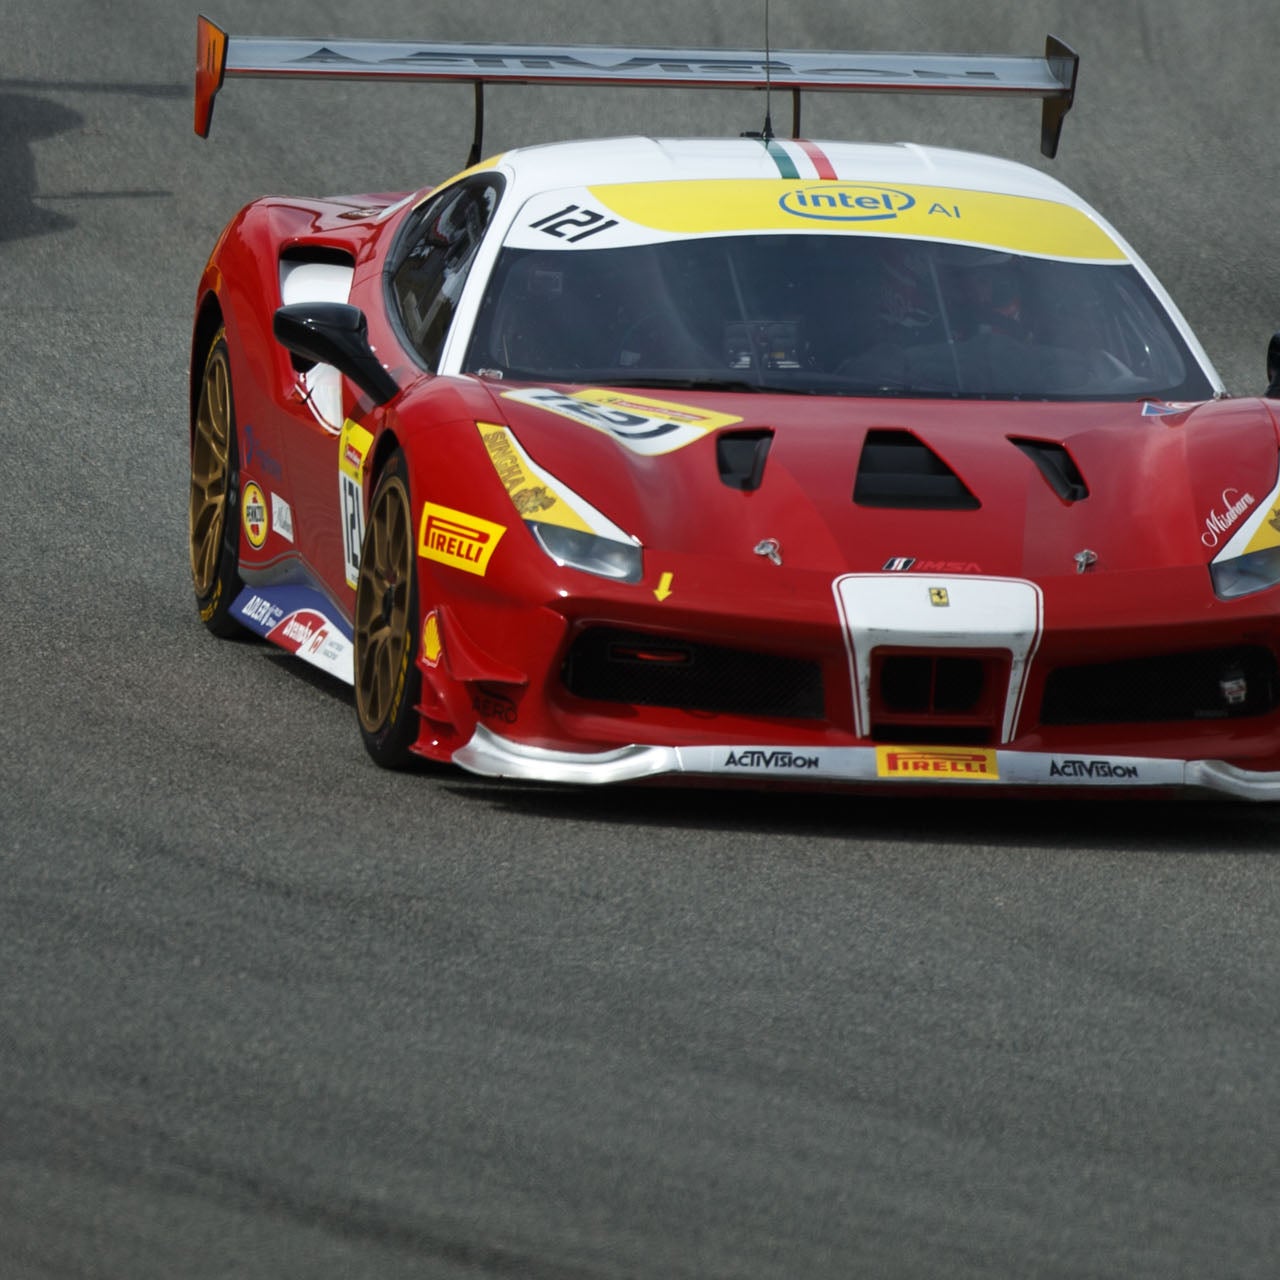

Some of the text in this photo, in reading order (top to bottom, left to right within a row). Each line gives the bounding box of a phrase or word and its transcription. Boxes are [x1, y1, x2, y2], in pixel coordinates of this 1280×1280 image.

[797, 189, 961, 219] intel AI
[530, 204, 618, 243] 121
[483, 431, 525, 492] SINGHA
[424, 515, 490, 563] PIRELLI
[914, 561, 982, 572] IMSA
[724, 751, 819, 769] ACTIVISION
[887, 752, 987, 774] PIRELLI
[1050, 760, 1138, 778] ACTIVISION
